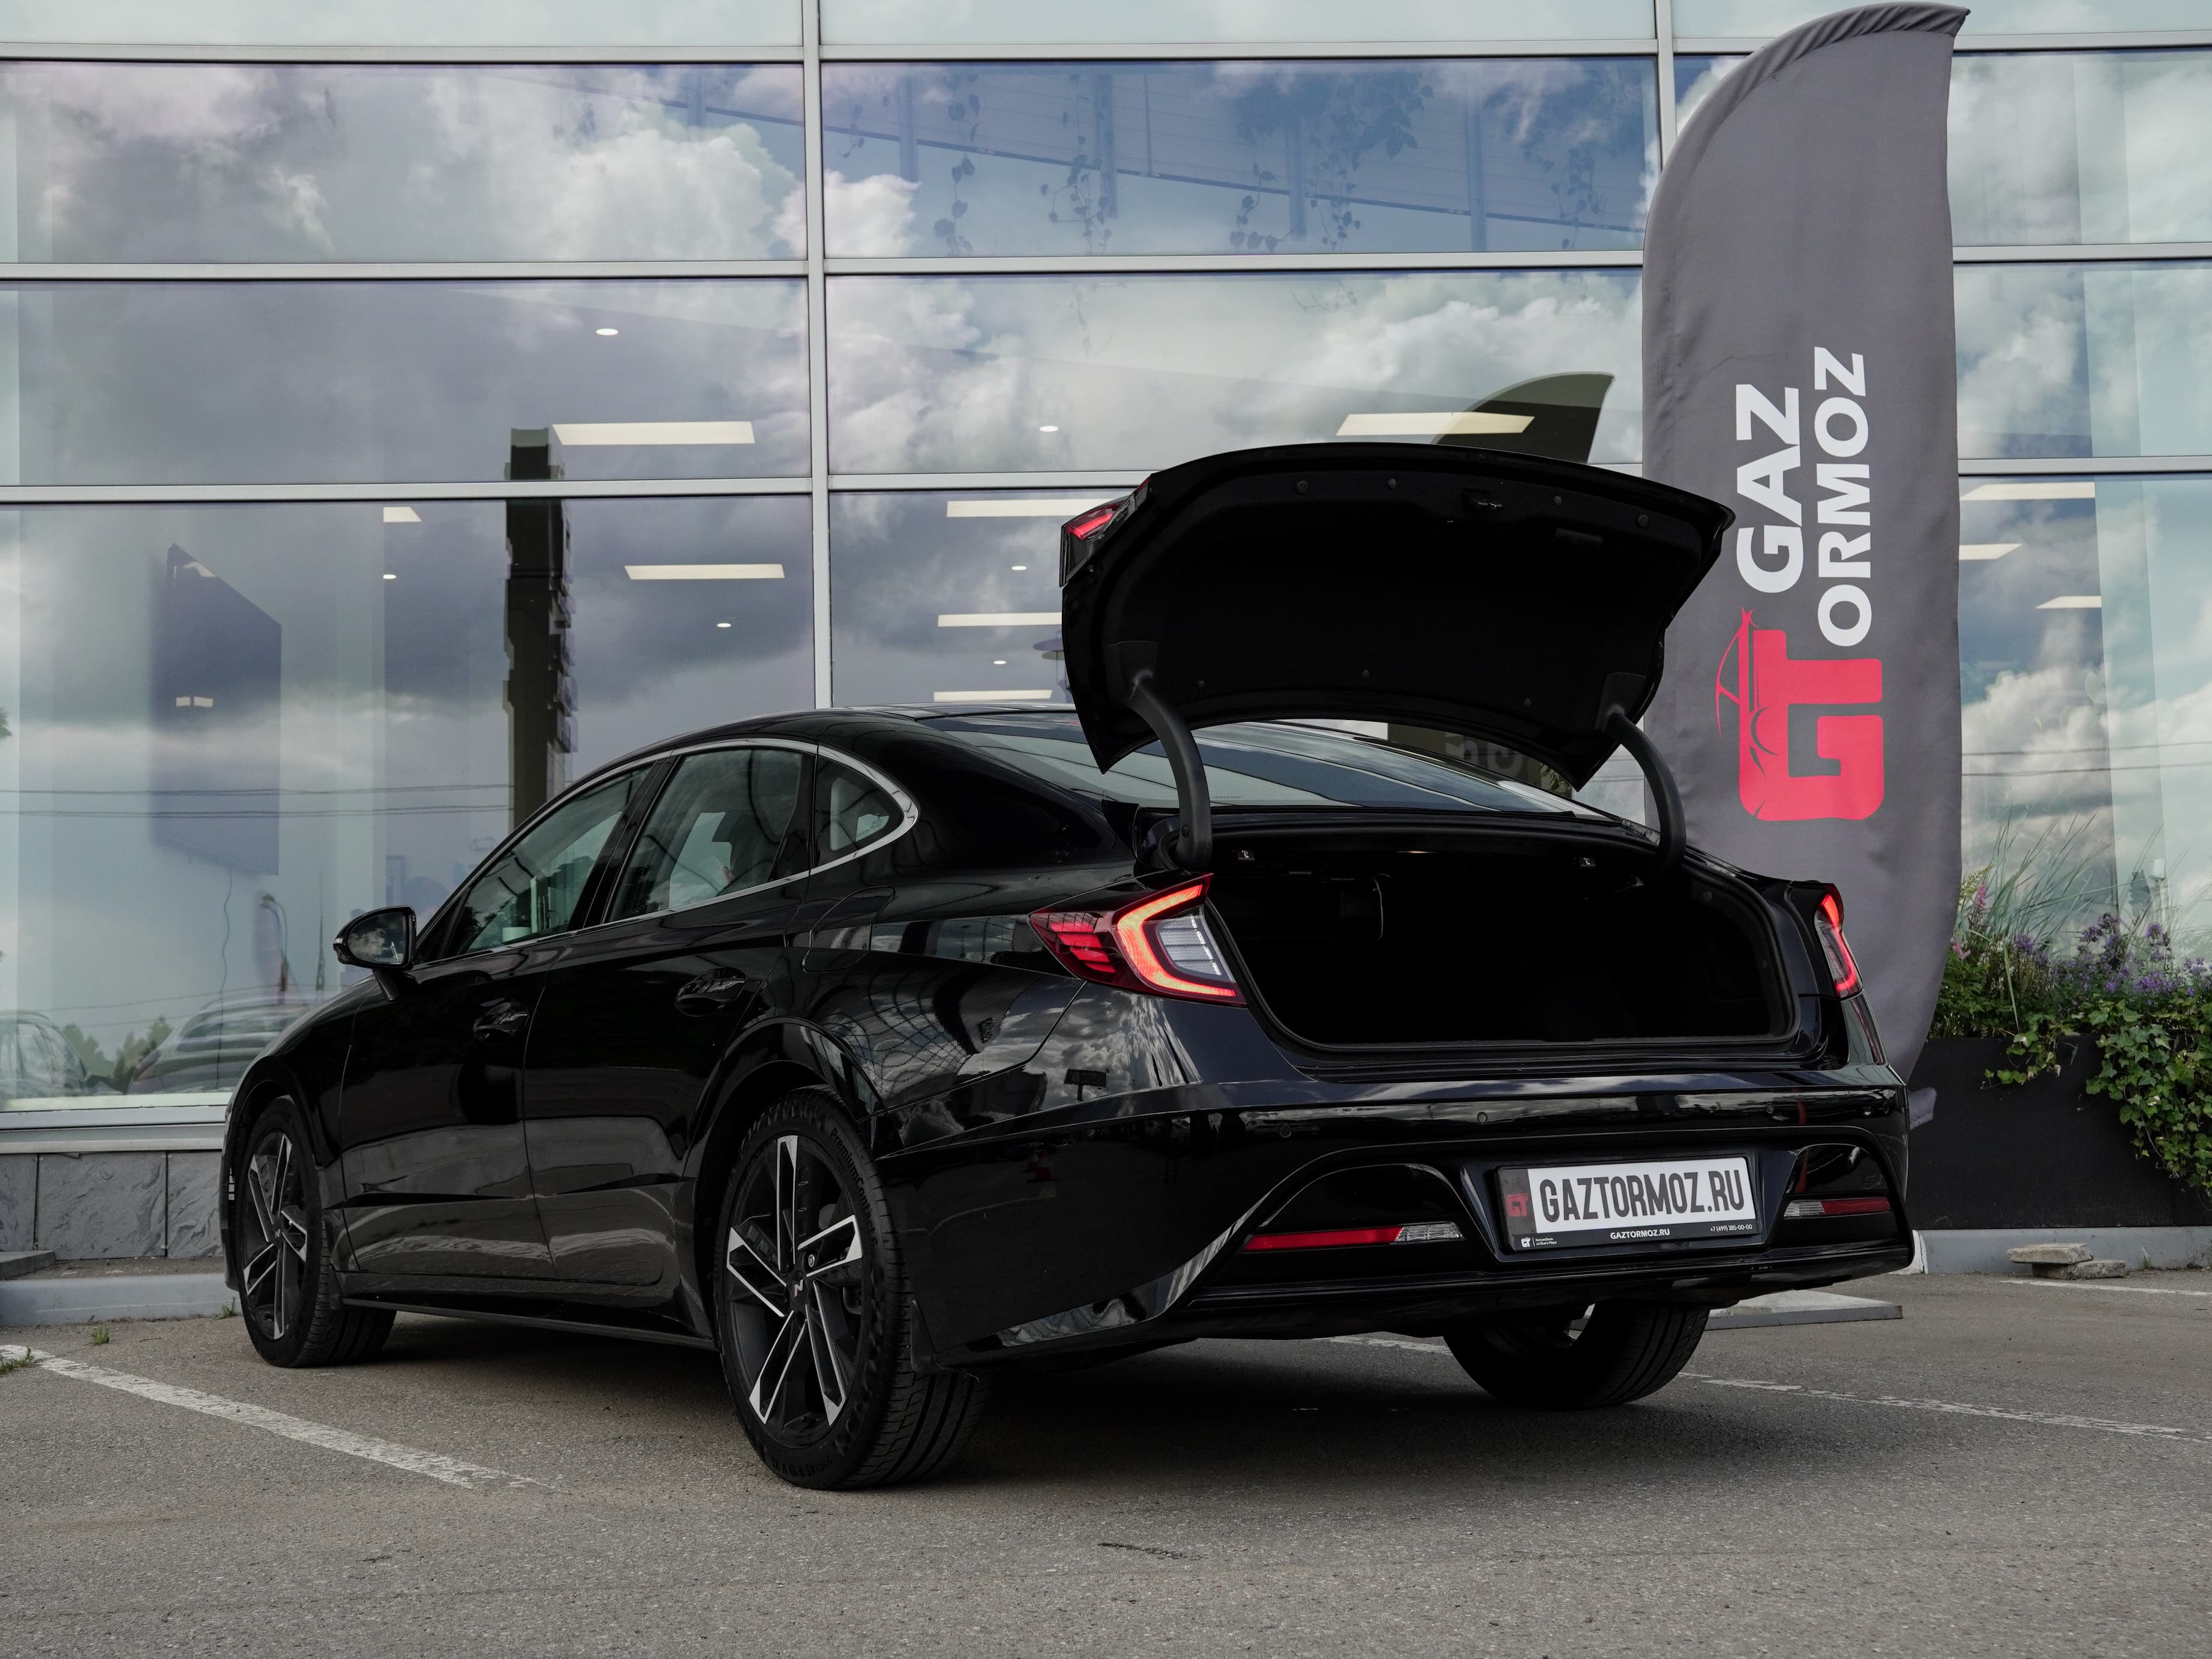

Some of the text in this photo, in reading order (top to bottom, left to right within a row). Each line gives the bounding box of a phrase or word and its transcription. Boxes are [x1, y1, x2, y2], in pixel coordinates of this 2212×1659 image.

[1735, 383, 1803, 593] GAZ
[1814, 346, 1872, 647] ORMOZ
[830, 1127, 875, 1233] PremiumContact
[1539, 1169, 1745, 1223] GAZTORMOZ.RU
[1610, 1228, 1670, 1240] GAZTORMOZ.RU
